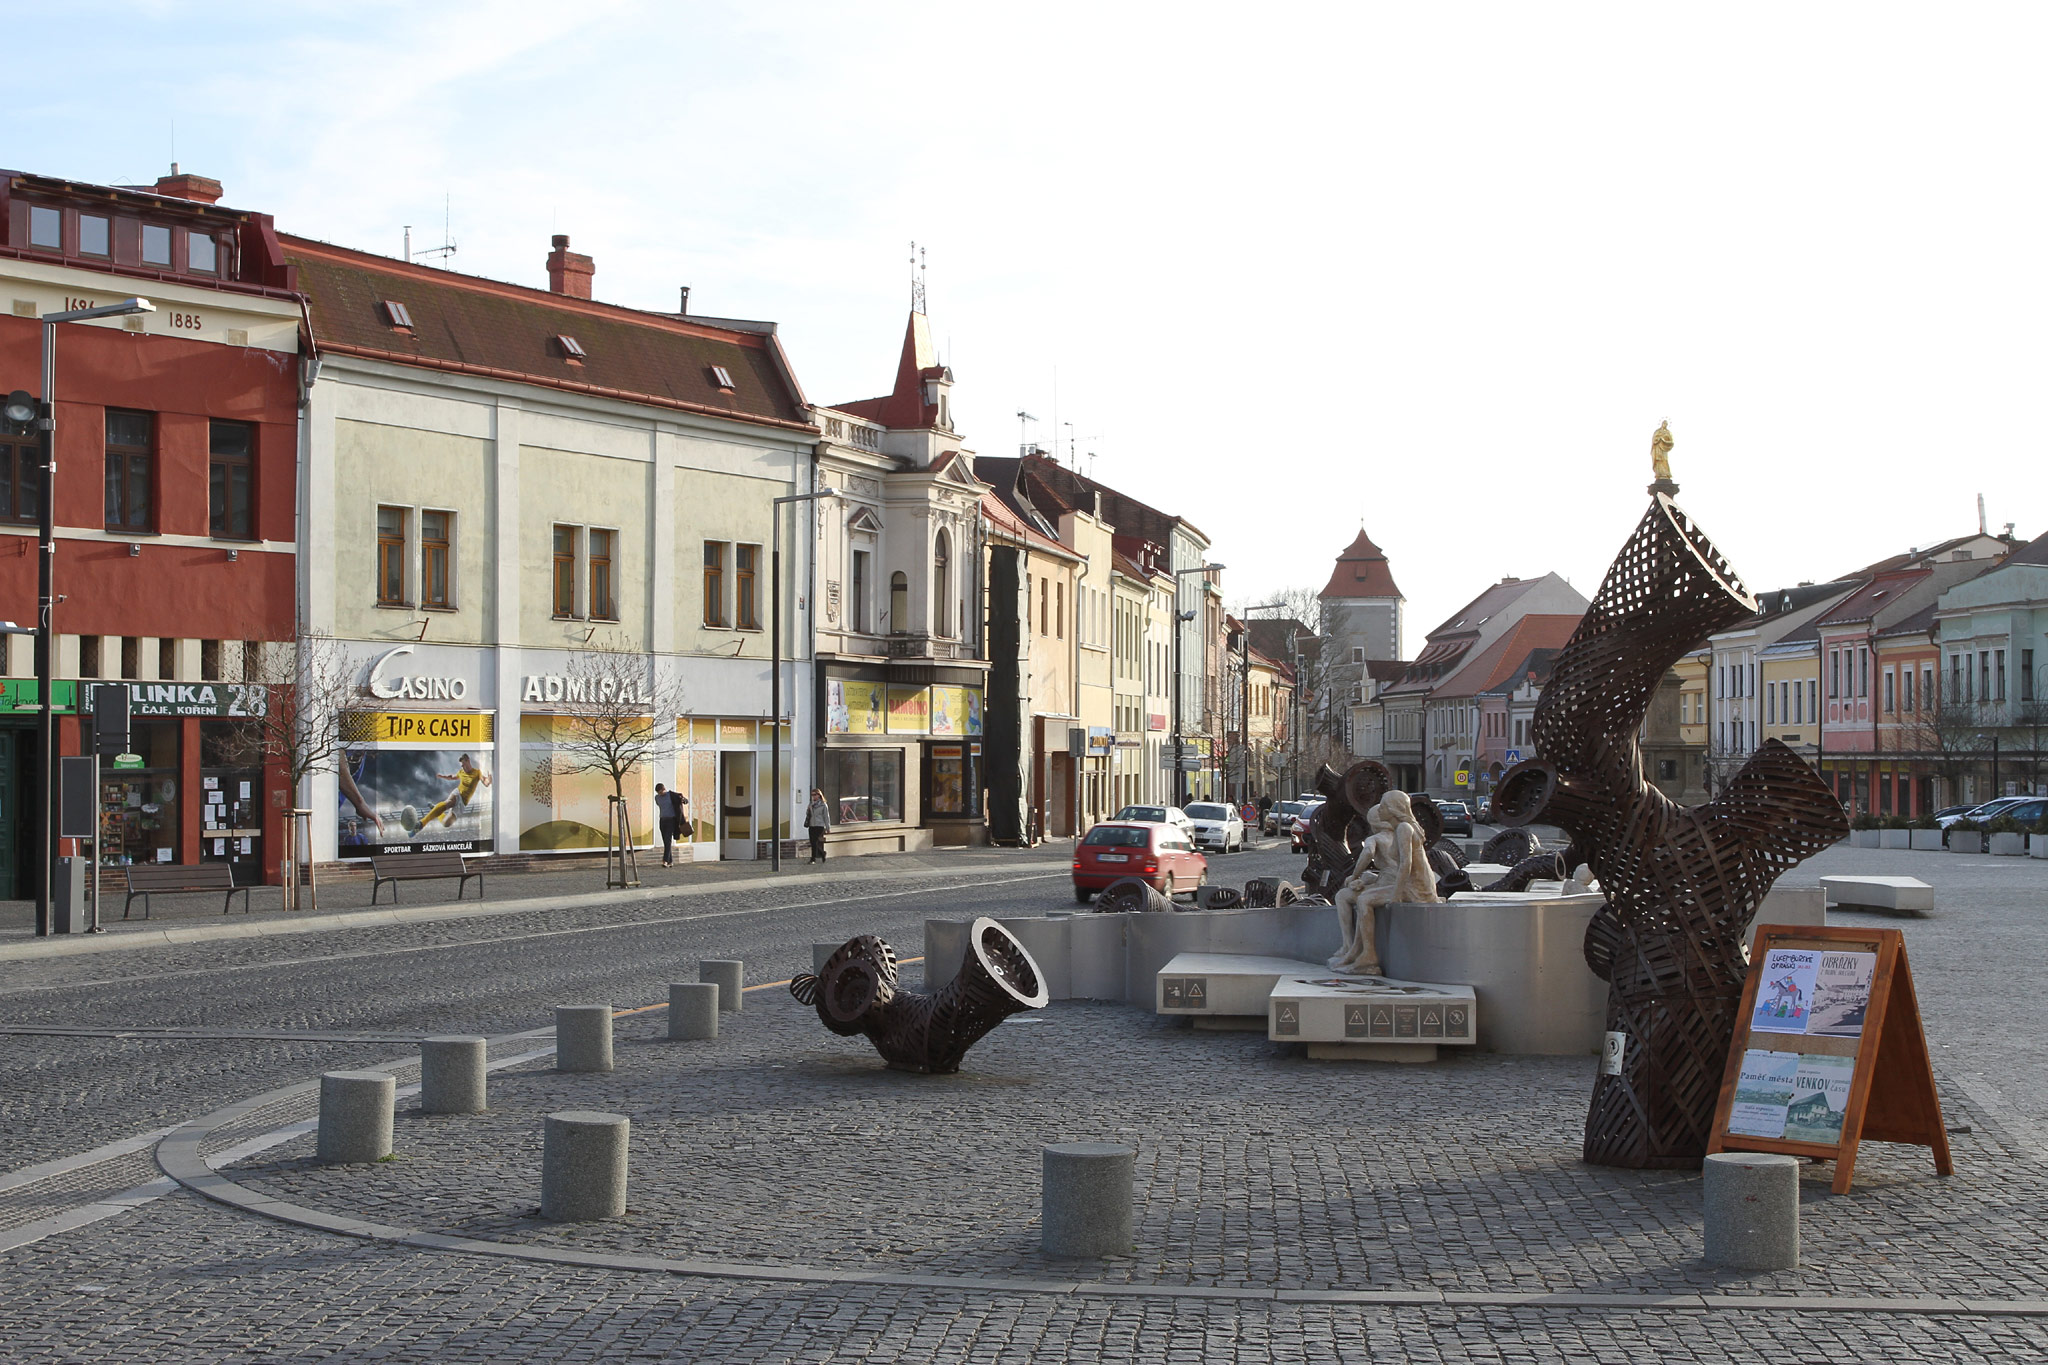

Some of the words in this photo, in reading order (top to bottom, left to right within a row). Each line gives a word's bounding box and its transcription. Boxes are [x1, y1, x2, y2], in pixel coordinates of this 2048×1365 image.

[169, 311, 202, 331] 1885
[370, 644, 467, 700] CASINO
[523, 675, 653, 705] ADMIRAL
[142, 703, 172, 715] ČAJE,
[176, 704, 218, 715] KOŘENÍ
[227, 684, 267, 717] 28
[386, 715, 414, 737] TIP
[416, 719, 426, 736] &
[429, 718, 471, 737] CASH
[383, 845, 412, 854] SPORTBAR
[422, 842, 447, 852] SÁZKOVÁ
[446, 841, 473, 851] KANCELÁŘ
[1821, 953, 1859, 970] OBRÁZKY
[1740, 1071, 1767, 1081] Paměť
[1768, 1075, 1793, 1084] města
[1796, 1076, 1831, 1091] VENKOV
